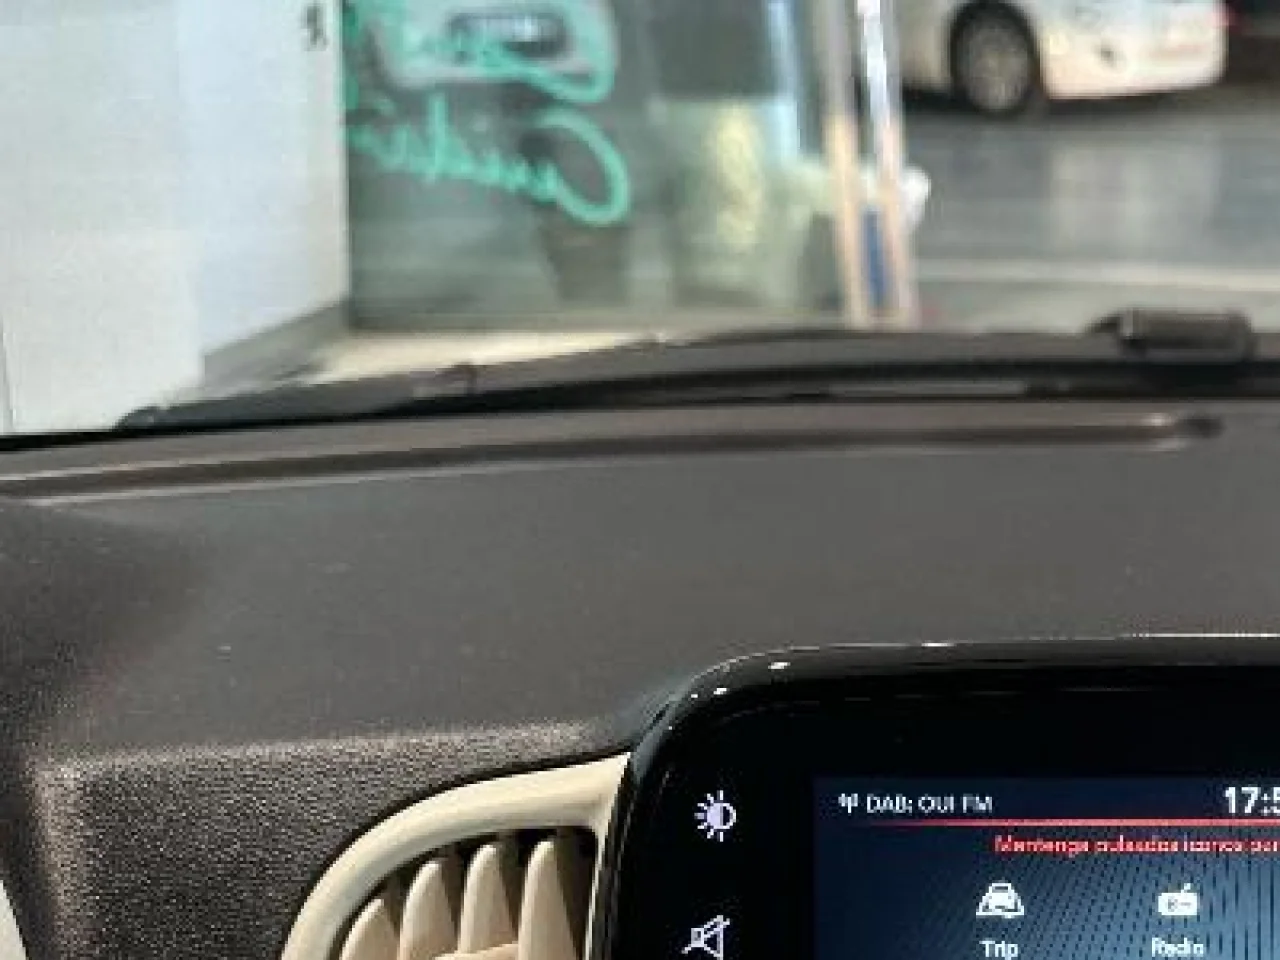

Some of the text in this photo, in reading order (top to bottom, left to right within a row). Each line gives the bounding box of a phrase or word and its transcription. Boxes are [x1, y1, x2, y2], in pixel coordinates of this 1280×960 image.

[917, 794, 955, 814] OUI
[961, 794, 993, 814] FM
[978, 939, 1019, 960] Trip
[1151, 937, 1205, 958] Radio
